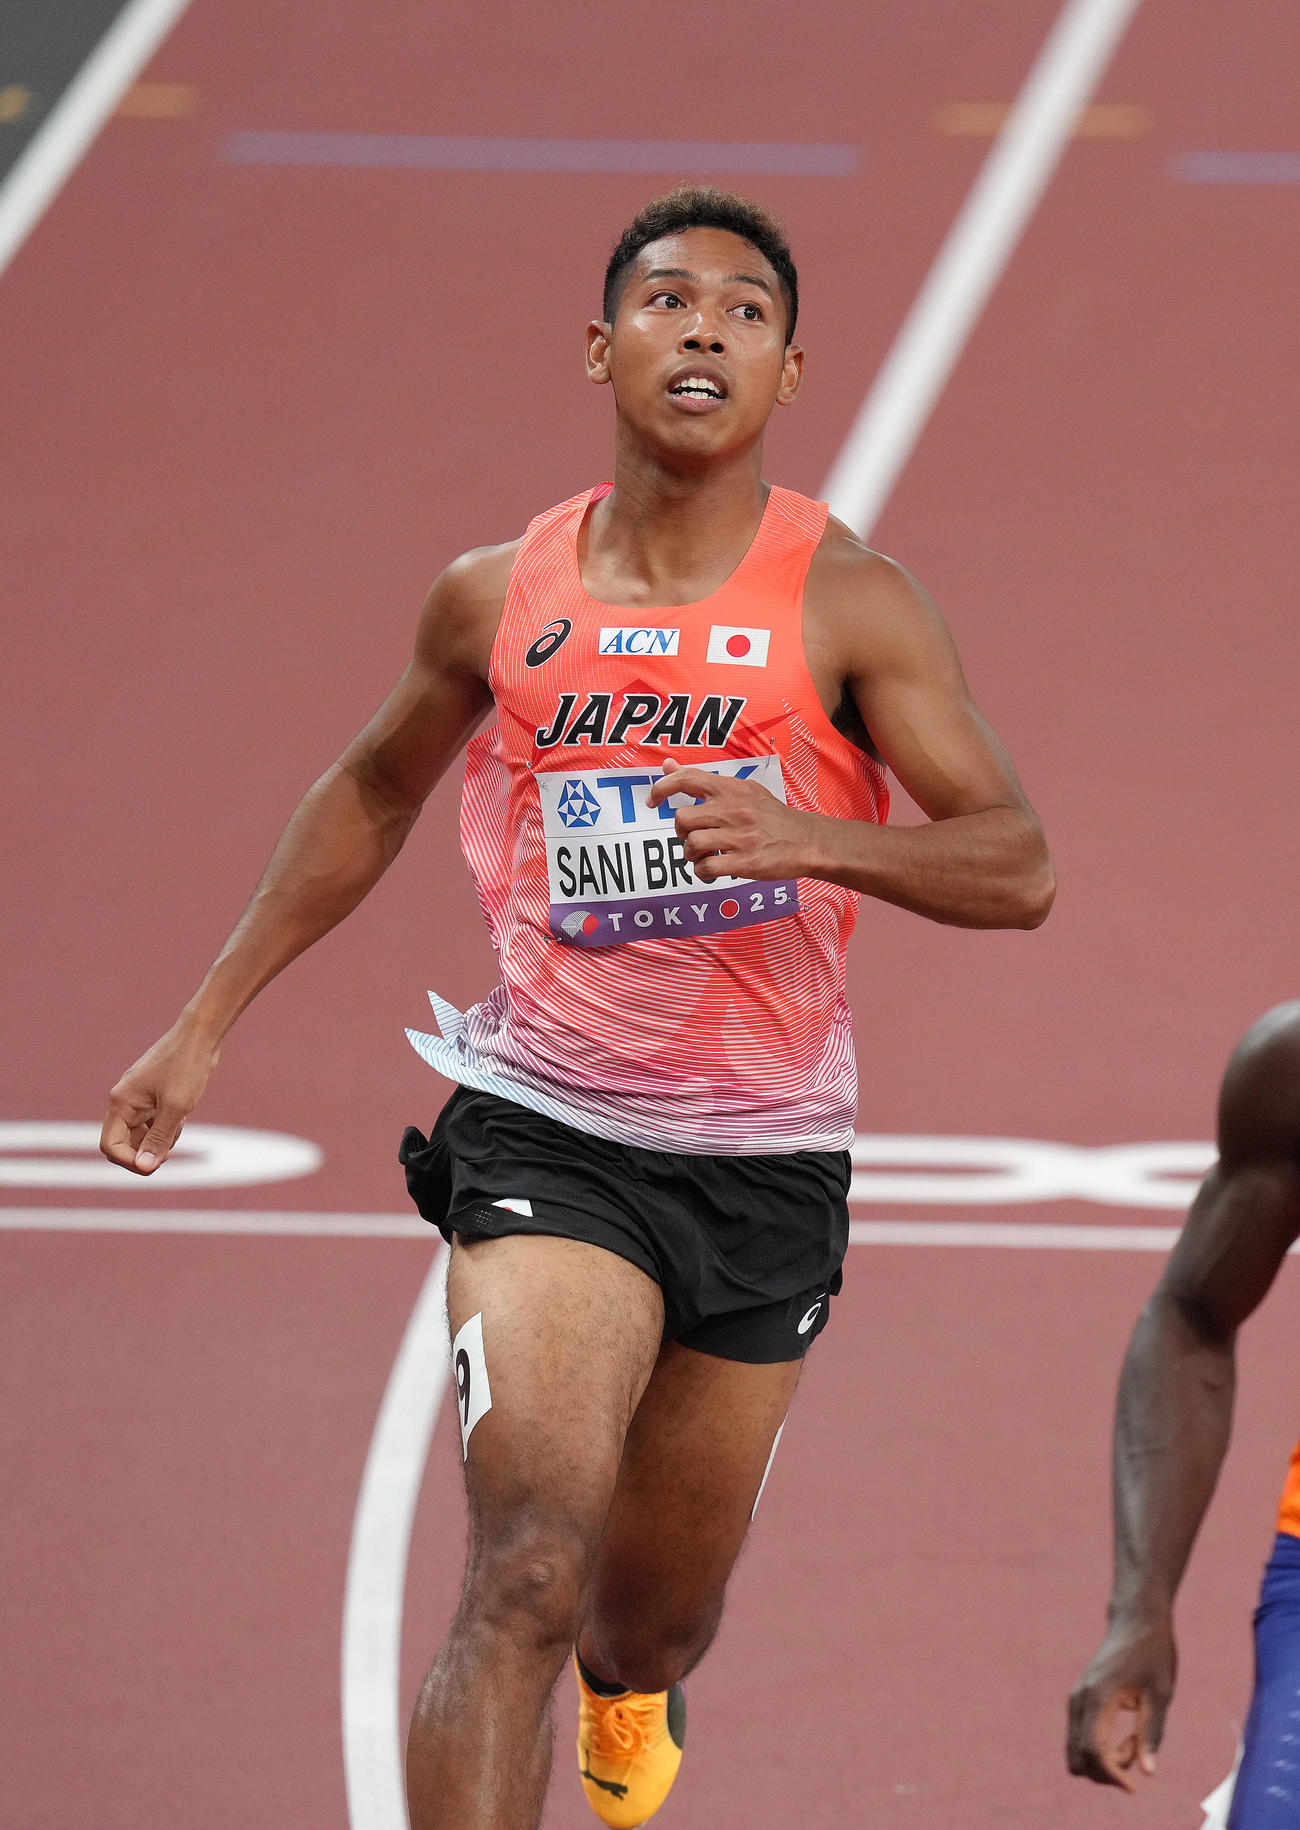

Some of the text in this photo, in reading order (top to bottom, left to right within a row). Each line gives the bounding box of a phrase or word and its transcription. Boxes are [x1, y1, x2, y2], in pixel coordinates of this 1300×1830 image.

[601, 629, 678, 655] ACN
[535, 692, 748, 748] JAPAN
[556, 842, 636, 898] SANI
[455, 1348, 471, 1428] 9
